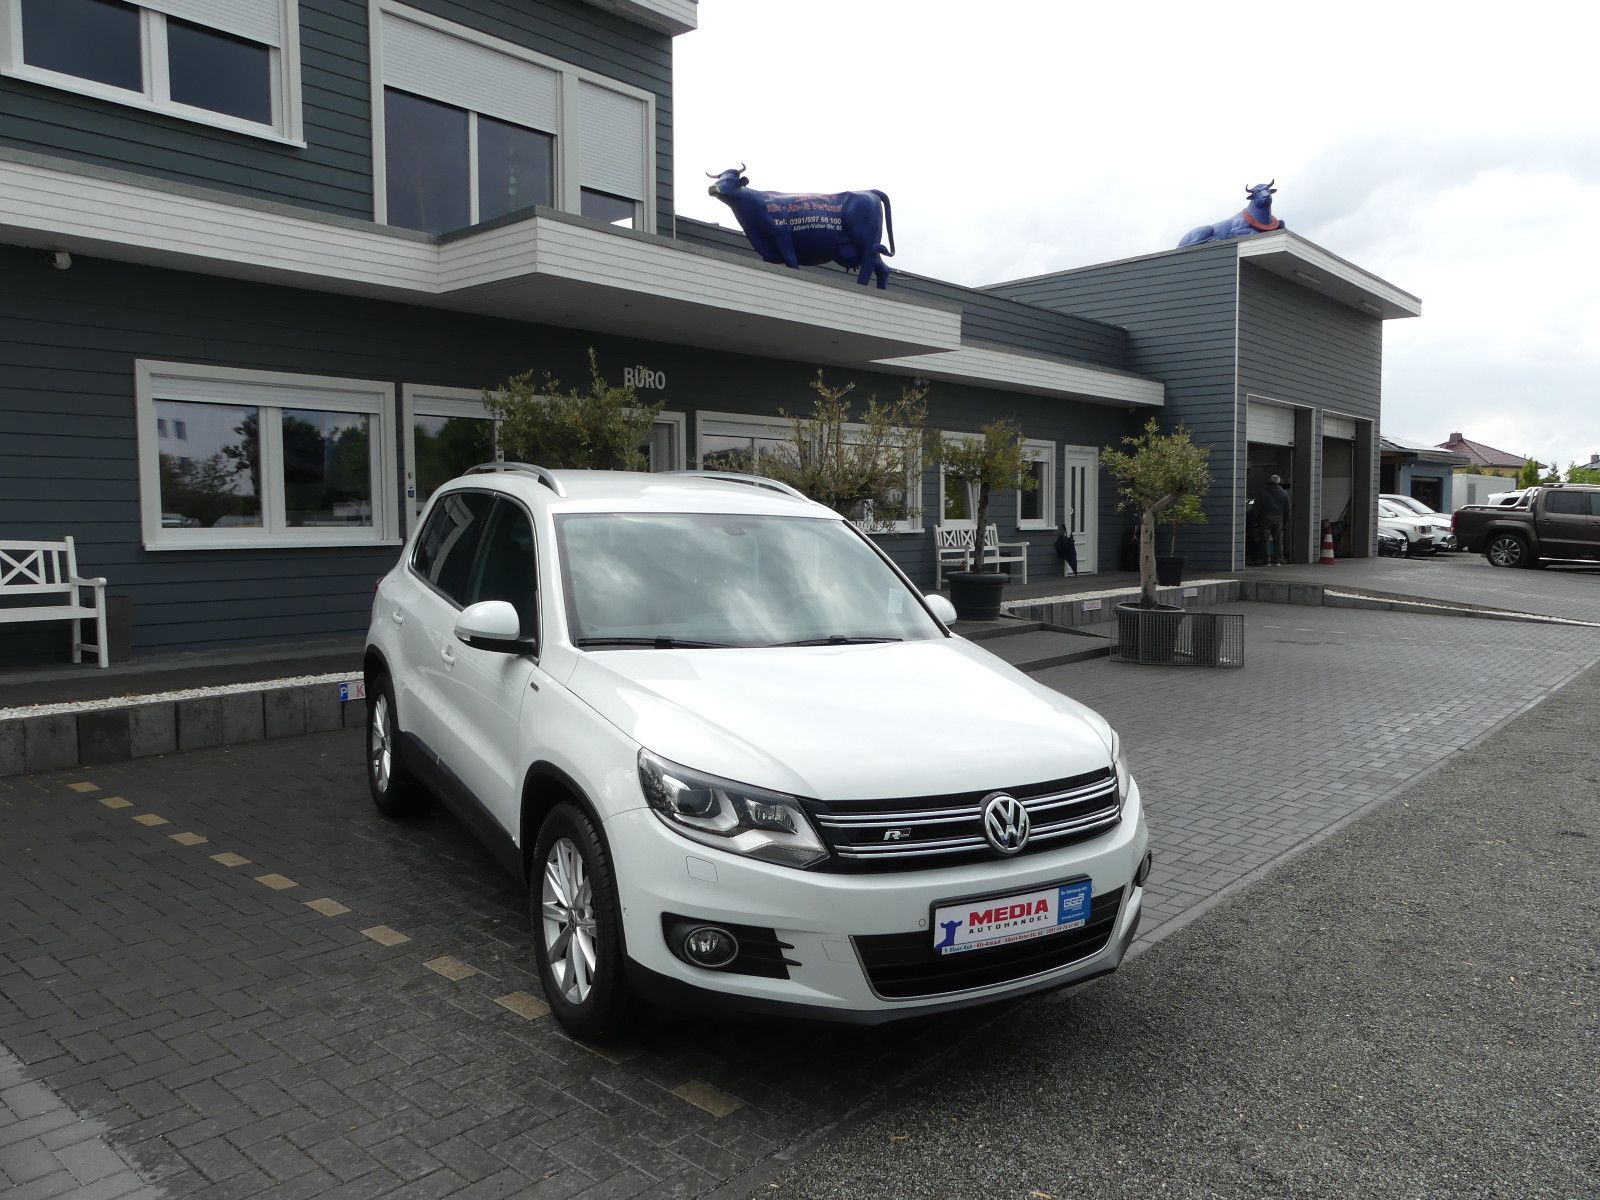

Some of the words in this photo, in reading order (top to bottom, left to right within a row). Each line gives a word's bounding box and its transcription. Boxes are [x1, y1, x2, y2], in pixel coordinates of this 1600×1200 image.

[774, 218, 787, 226] Tel.
[623, 365, 666, 390] BÜRO
[969, 899, 1049, 927] MEDIA
[969, 915, 1048, 934] AUTOHANDEL
